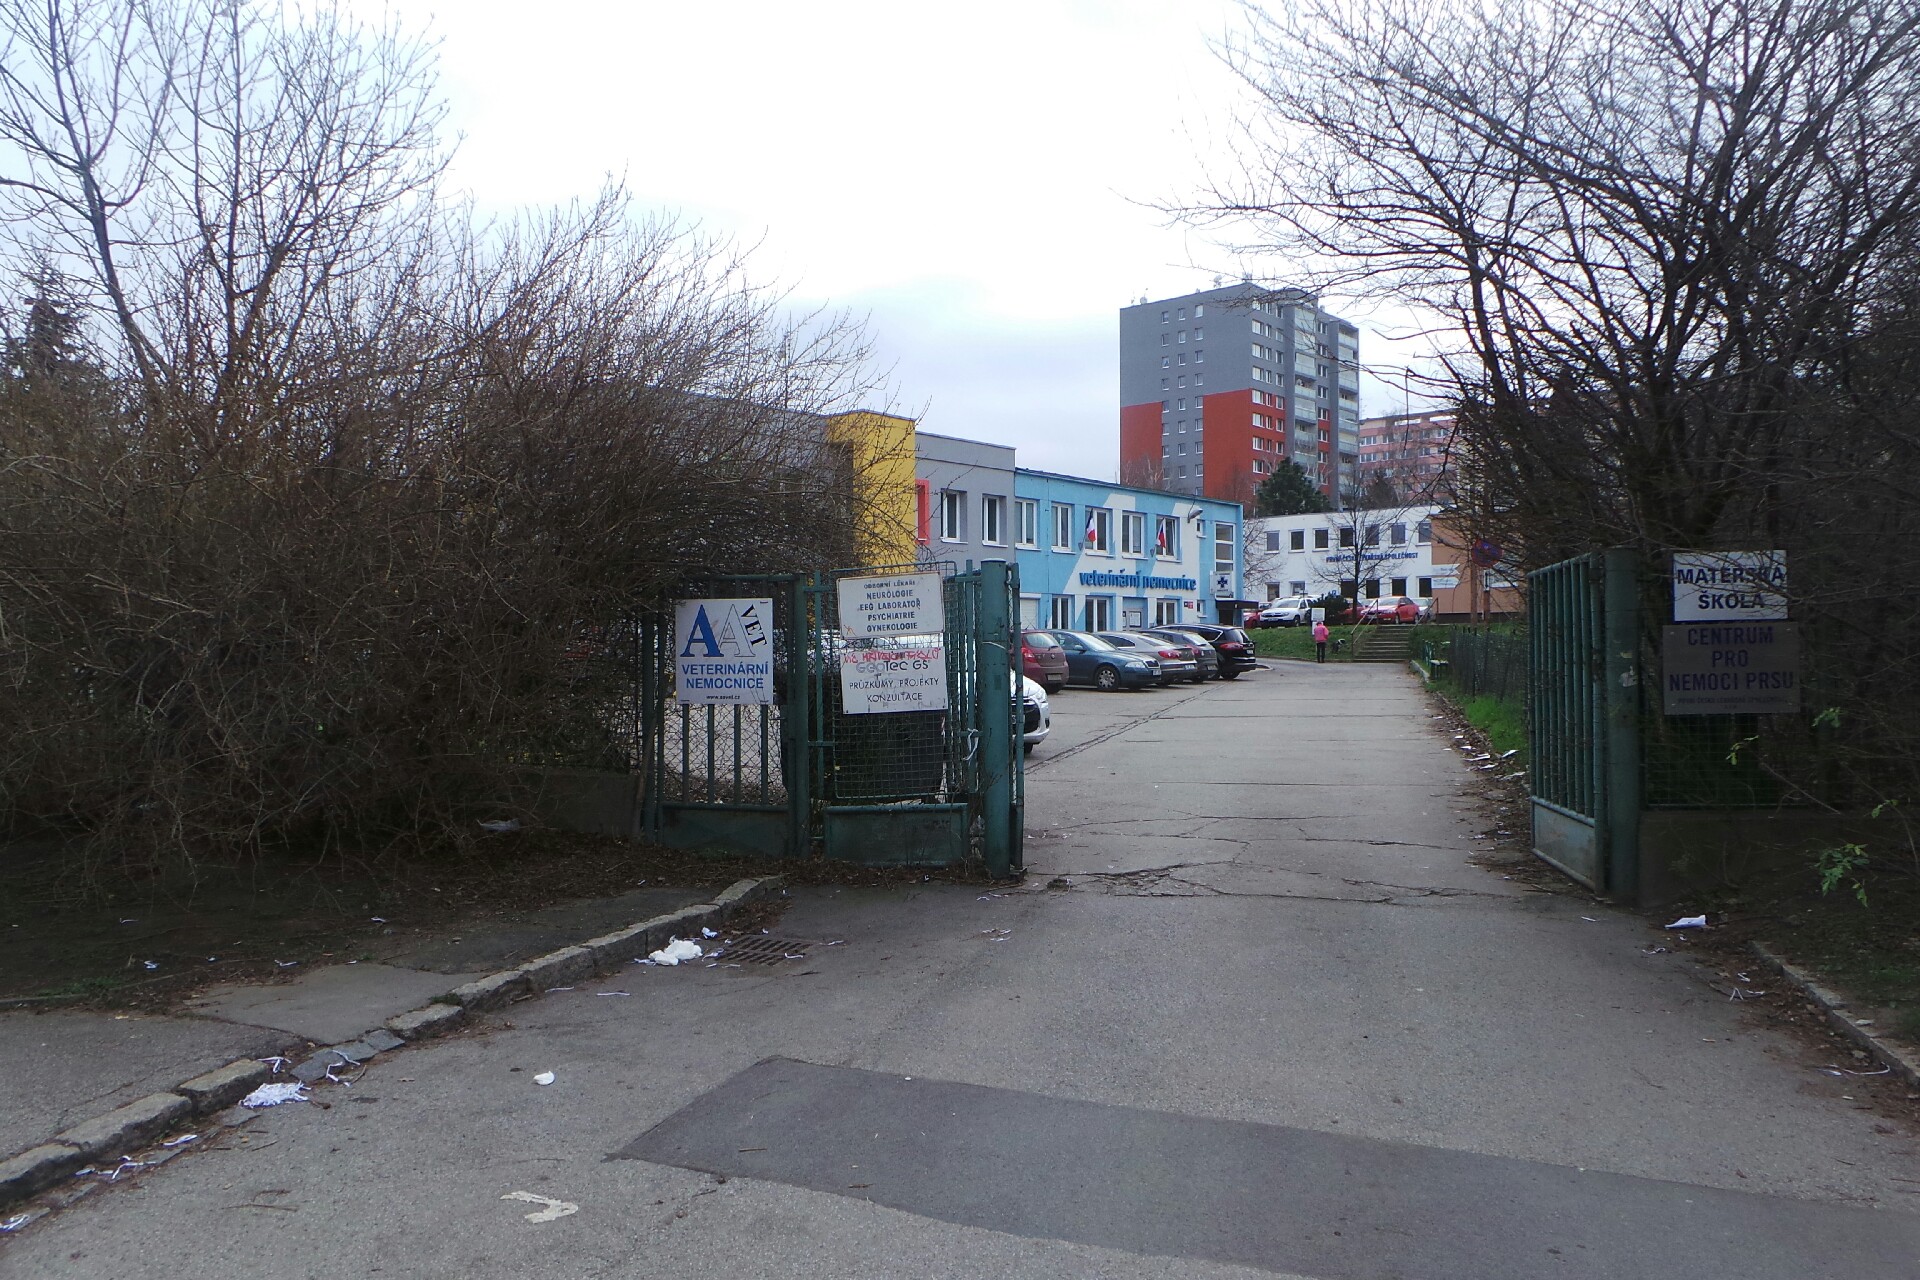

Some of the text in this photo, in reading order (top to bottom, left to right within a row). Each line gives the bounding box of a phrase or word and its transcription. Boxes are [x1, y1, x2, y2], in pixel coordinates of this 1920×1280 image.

[1079, 569, 1197, 590] veterinární nemocnice
[1698, 590, 1765, 610] ŠKOLA
[860, 604, 874, 612] EEG
[867, 611, 915, 622] PSYCHIATRIE
[741, 604, 767, 647] VET
[866, 622, 918, 633] GYNEKOLOGIE
[1688, 626, 1774, 646] CENTRUM
[1711, 649, 1749, 668] PRO
[682, 661, 768, 675] VETERINÁRNÍ
[686, 678, 764, 689] NEMOCNICE
[899, 677, 940, 687] PROJEKTY
[1669, 671, 1794, 691] NEMOCI PRSU
[866, 692, 923, 703] KONZULTACE
